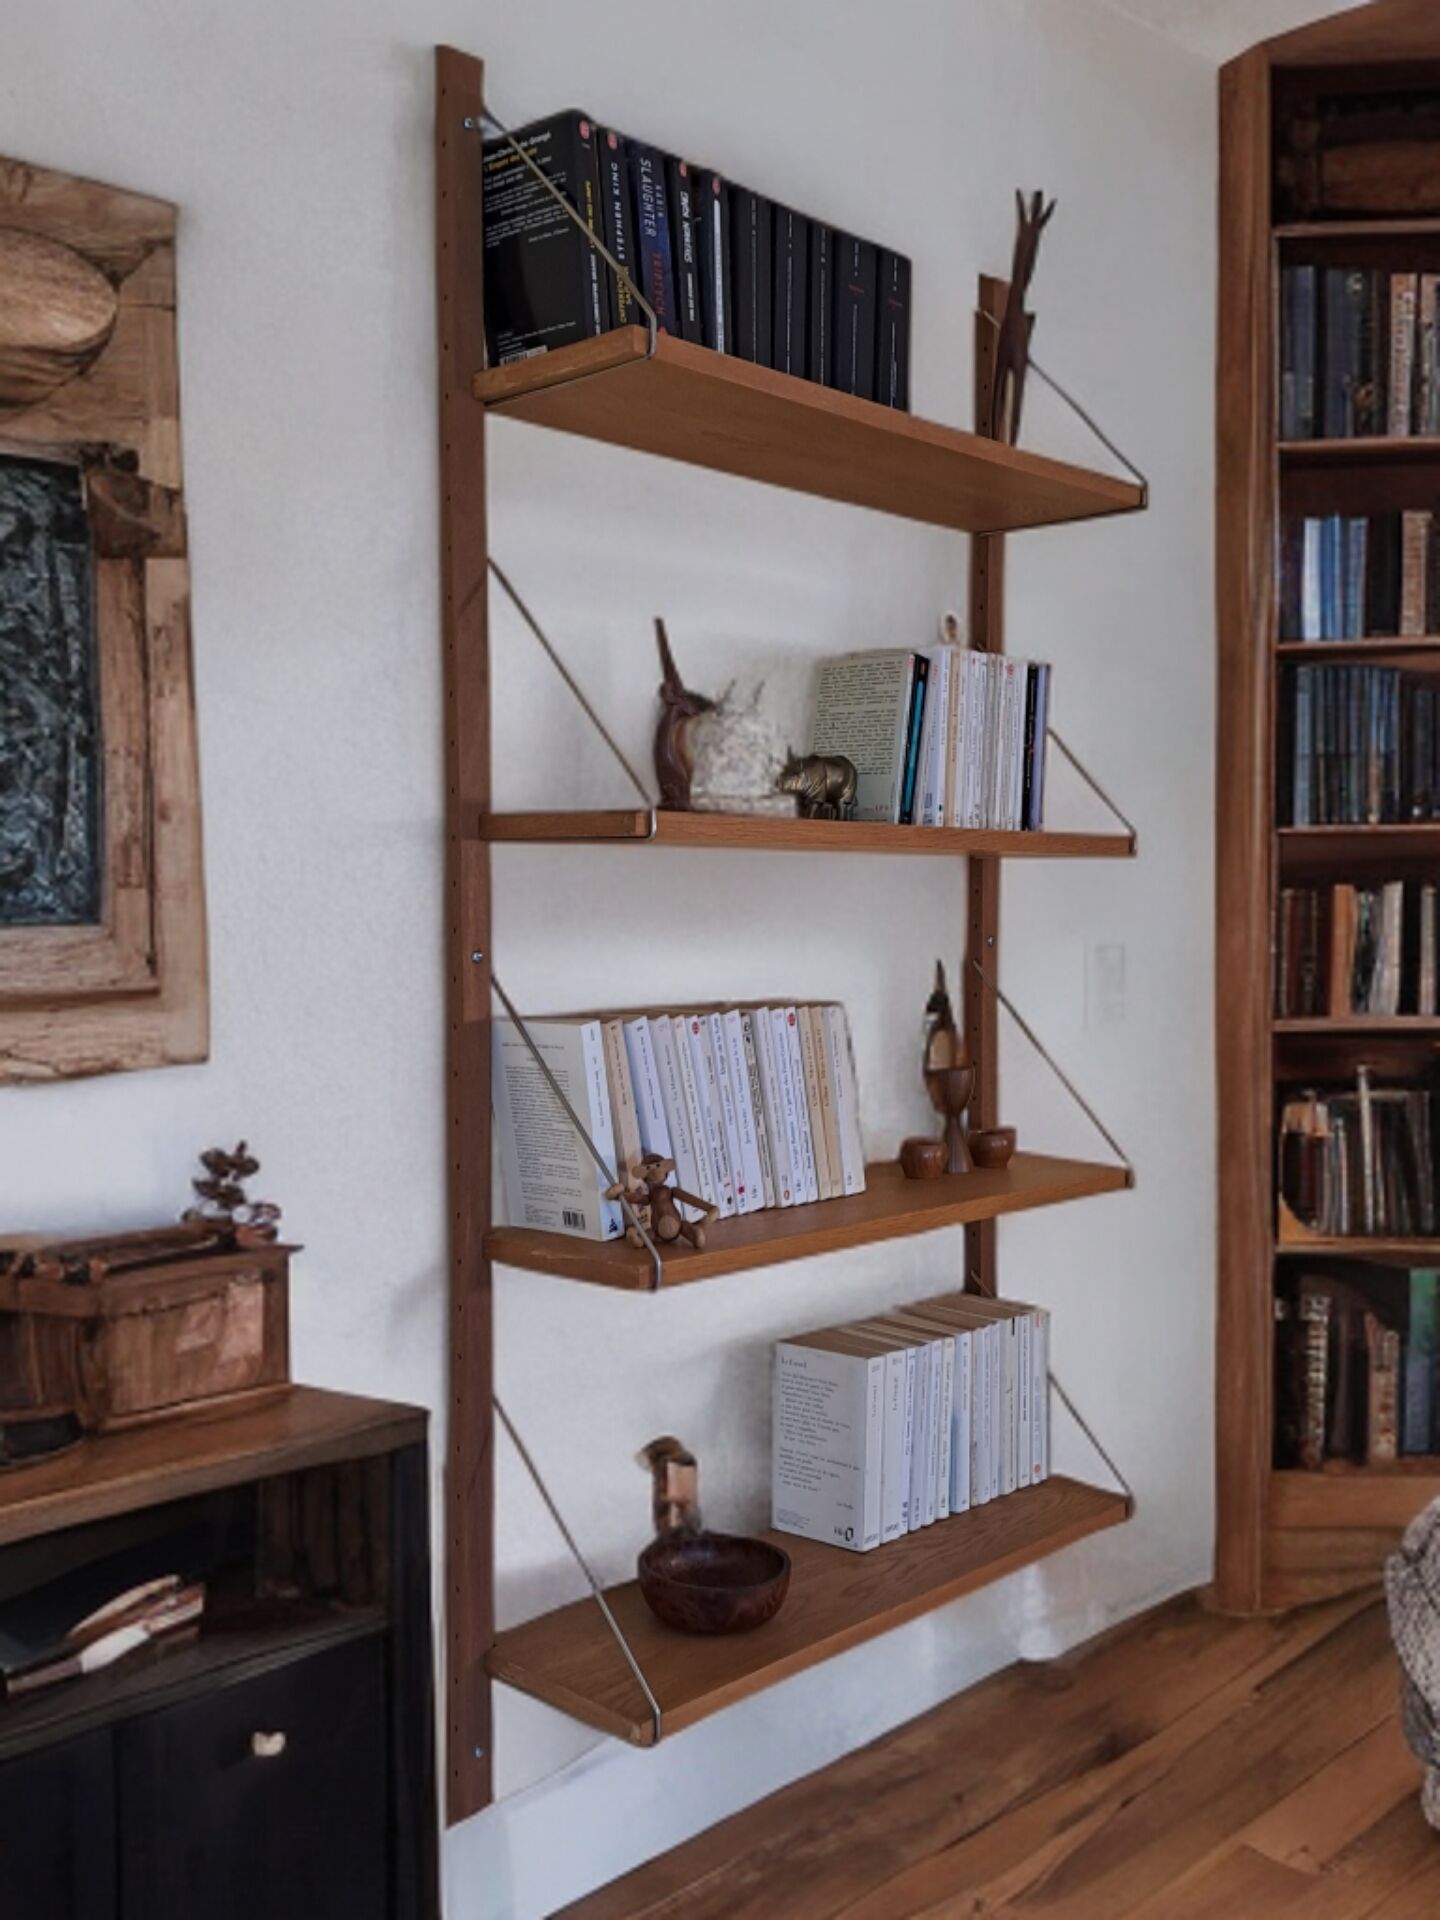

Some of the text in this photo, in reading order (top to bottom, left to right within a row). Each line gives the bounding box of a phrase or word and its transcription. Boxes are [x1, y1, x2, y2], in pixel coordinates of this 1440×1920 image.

[610, 162, 625, 260] STEPHEN KING
[640, 157, 657, 237] SLAUGHTER
